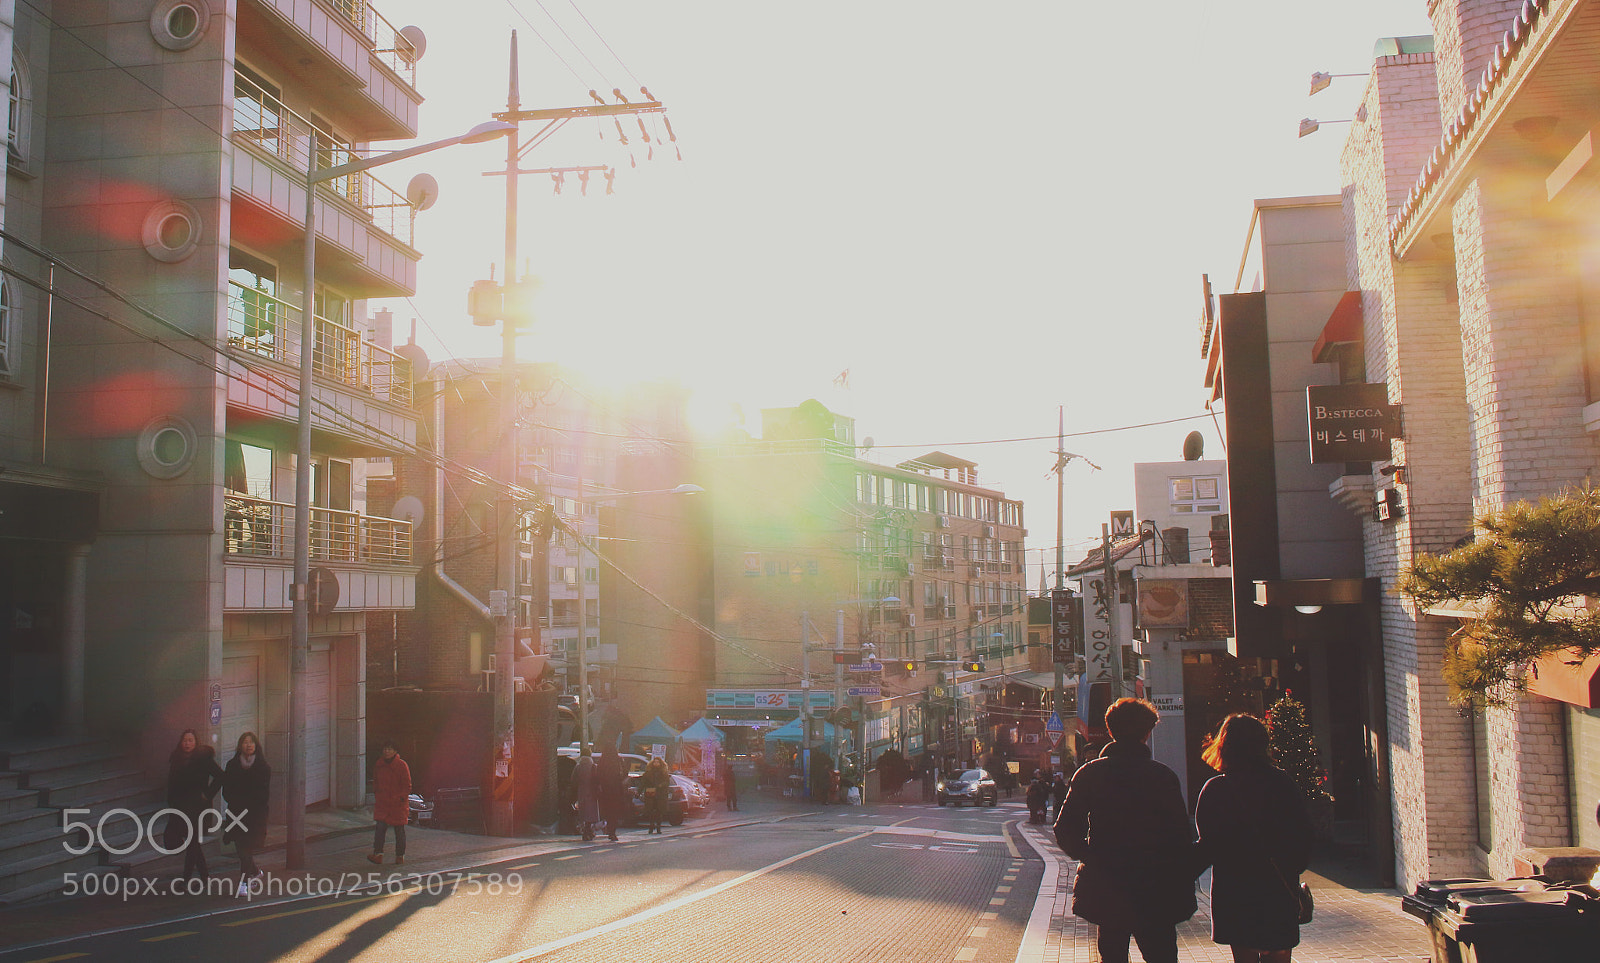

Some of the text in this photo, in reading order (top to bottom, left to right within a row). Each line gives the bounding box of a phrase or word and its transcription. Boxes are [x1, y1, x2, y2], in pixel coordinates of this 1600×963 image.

[1316, 427, 1385, 445] 비스테까
[1113, 517, 1132, 534] M
[1057, 604, 1072, 652] 부동산
[756, 693, 786, 706] GS25
